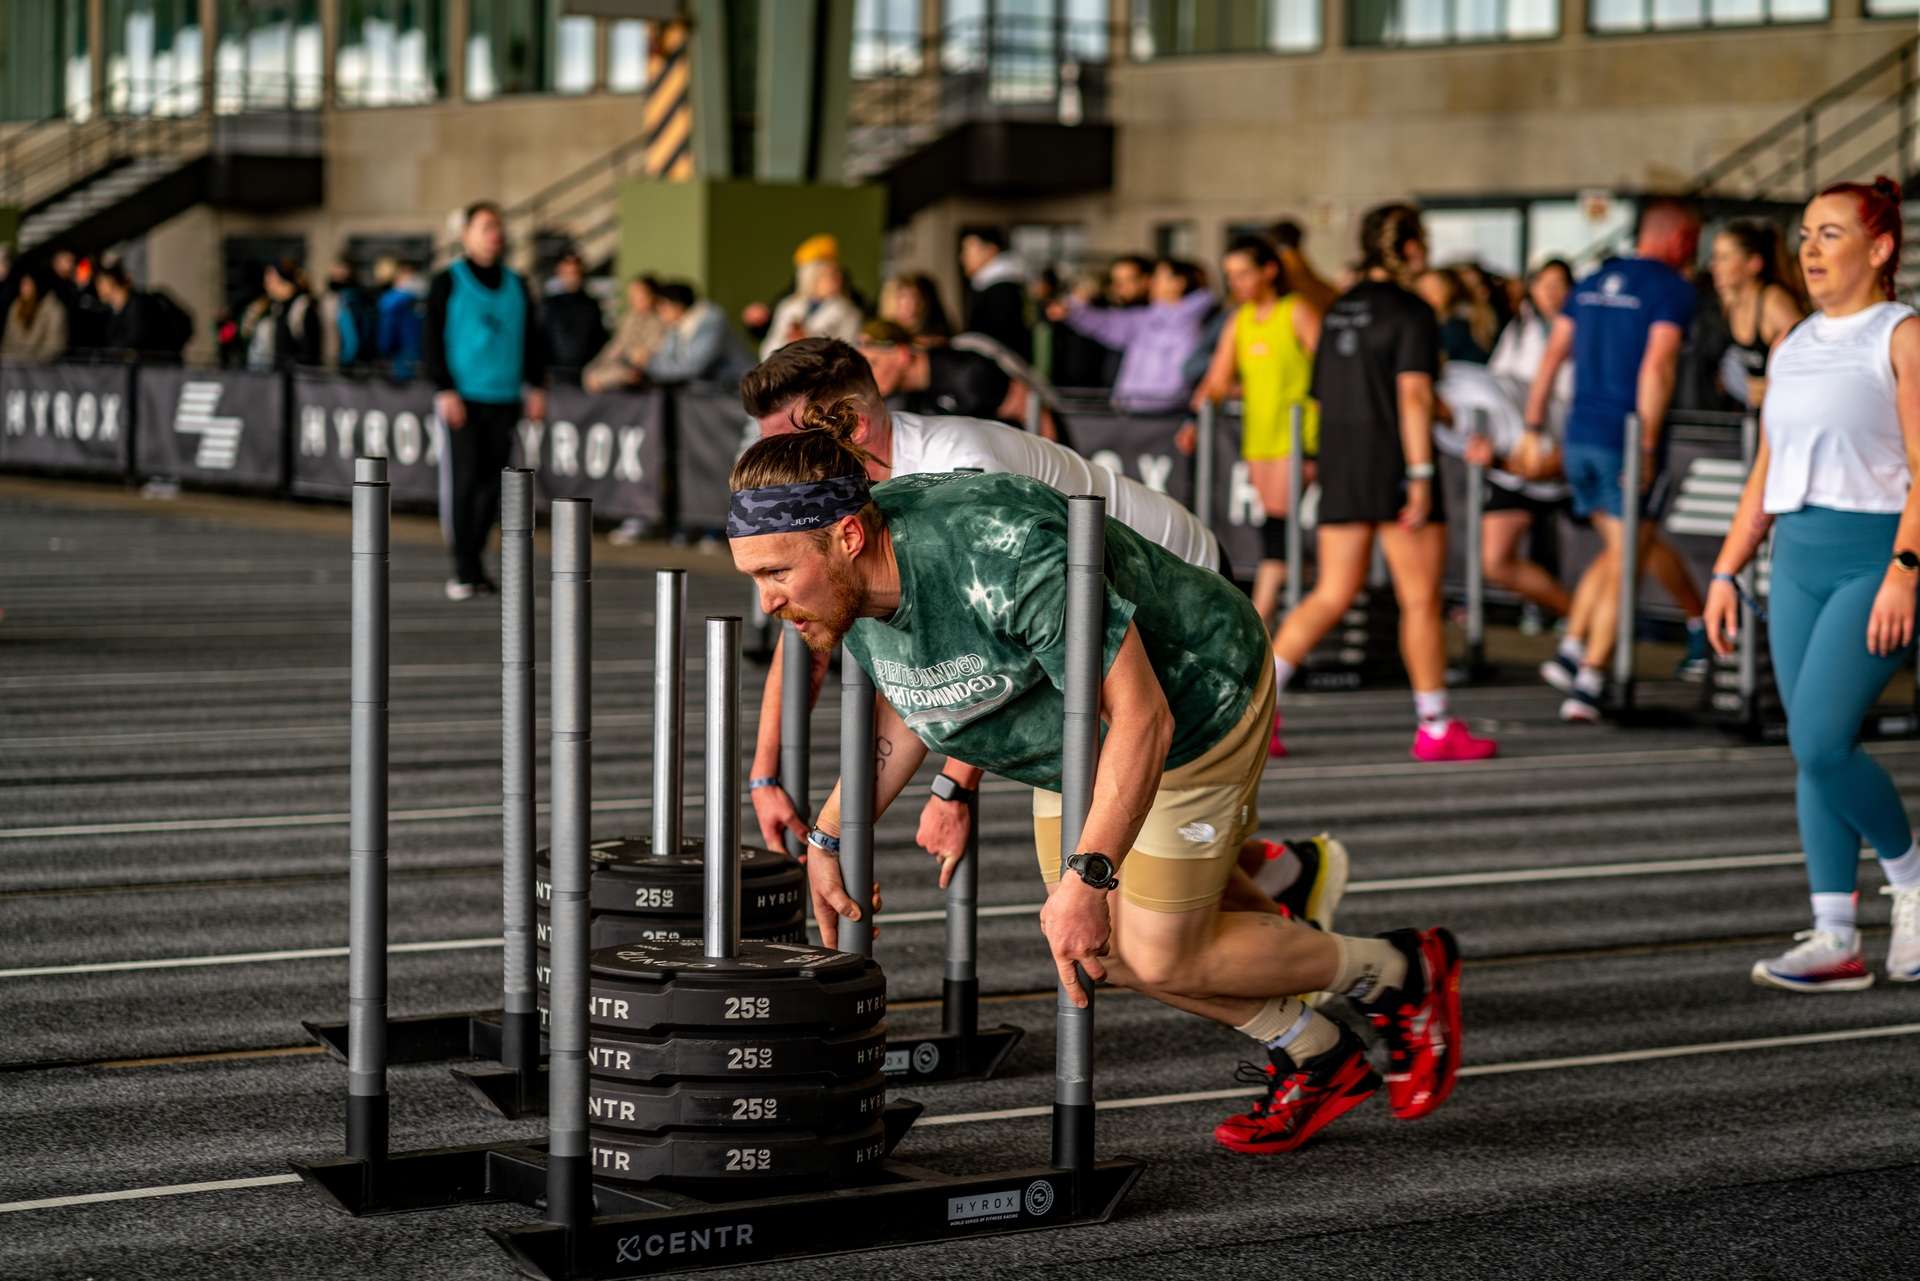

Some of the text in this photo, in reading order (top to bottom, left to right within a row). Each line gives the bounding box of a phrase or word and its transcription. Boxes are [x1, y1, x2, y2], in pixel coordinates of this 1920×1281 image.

[6, 390, 120, 441] HYROX
[515, 418, 644, 482] YROX
[588, 1096, 635, 1121] NTR
[955, 1196, 1014, 1214] HYROX
[644, 1223, 754, 1257] CENTR
